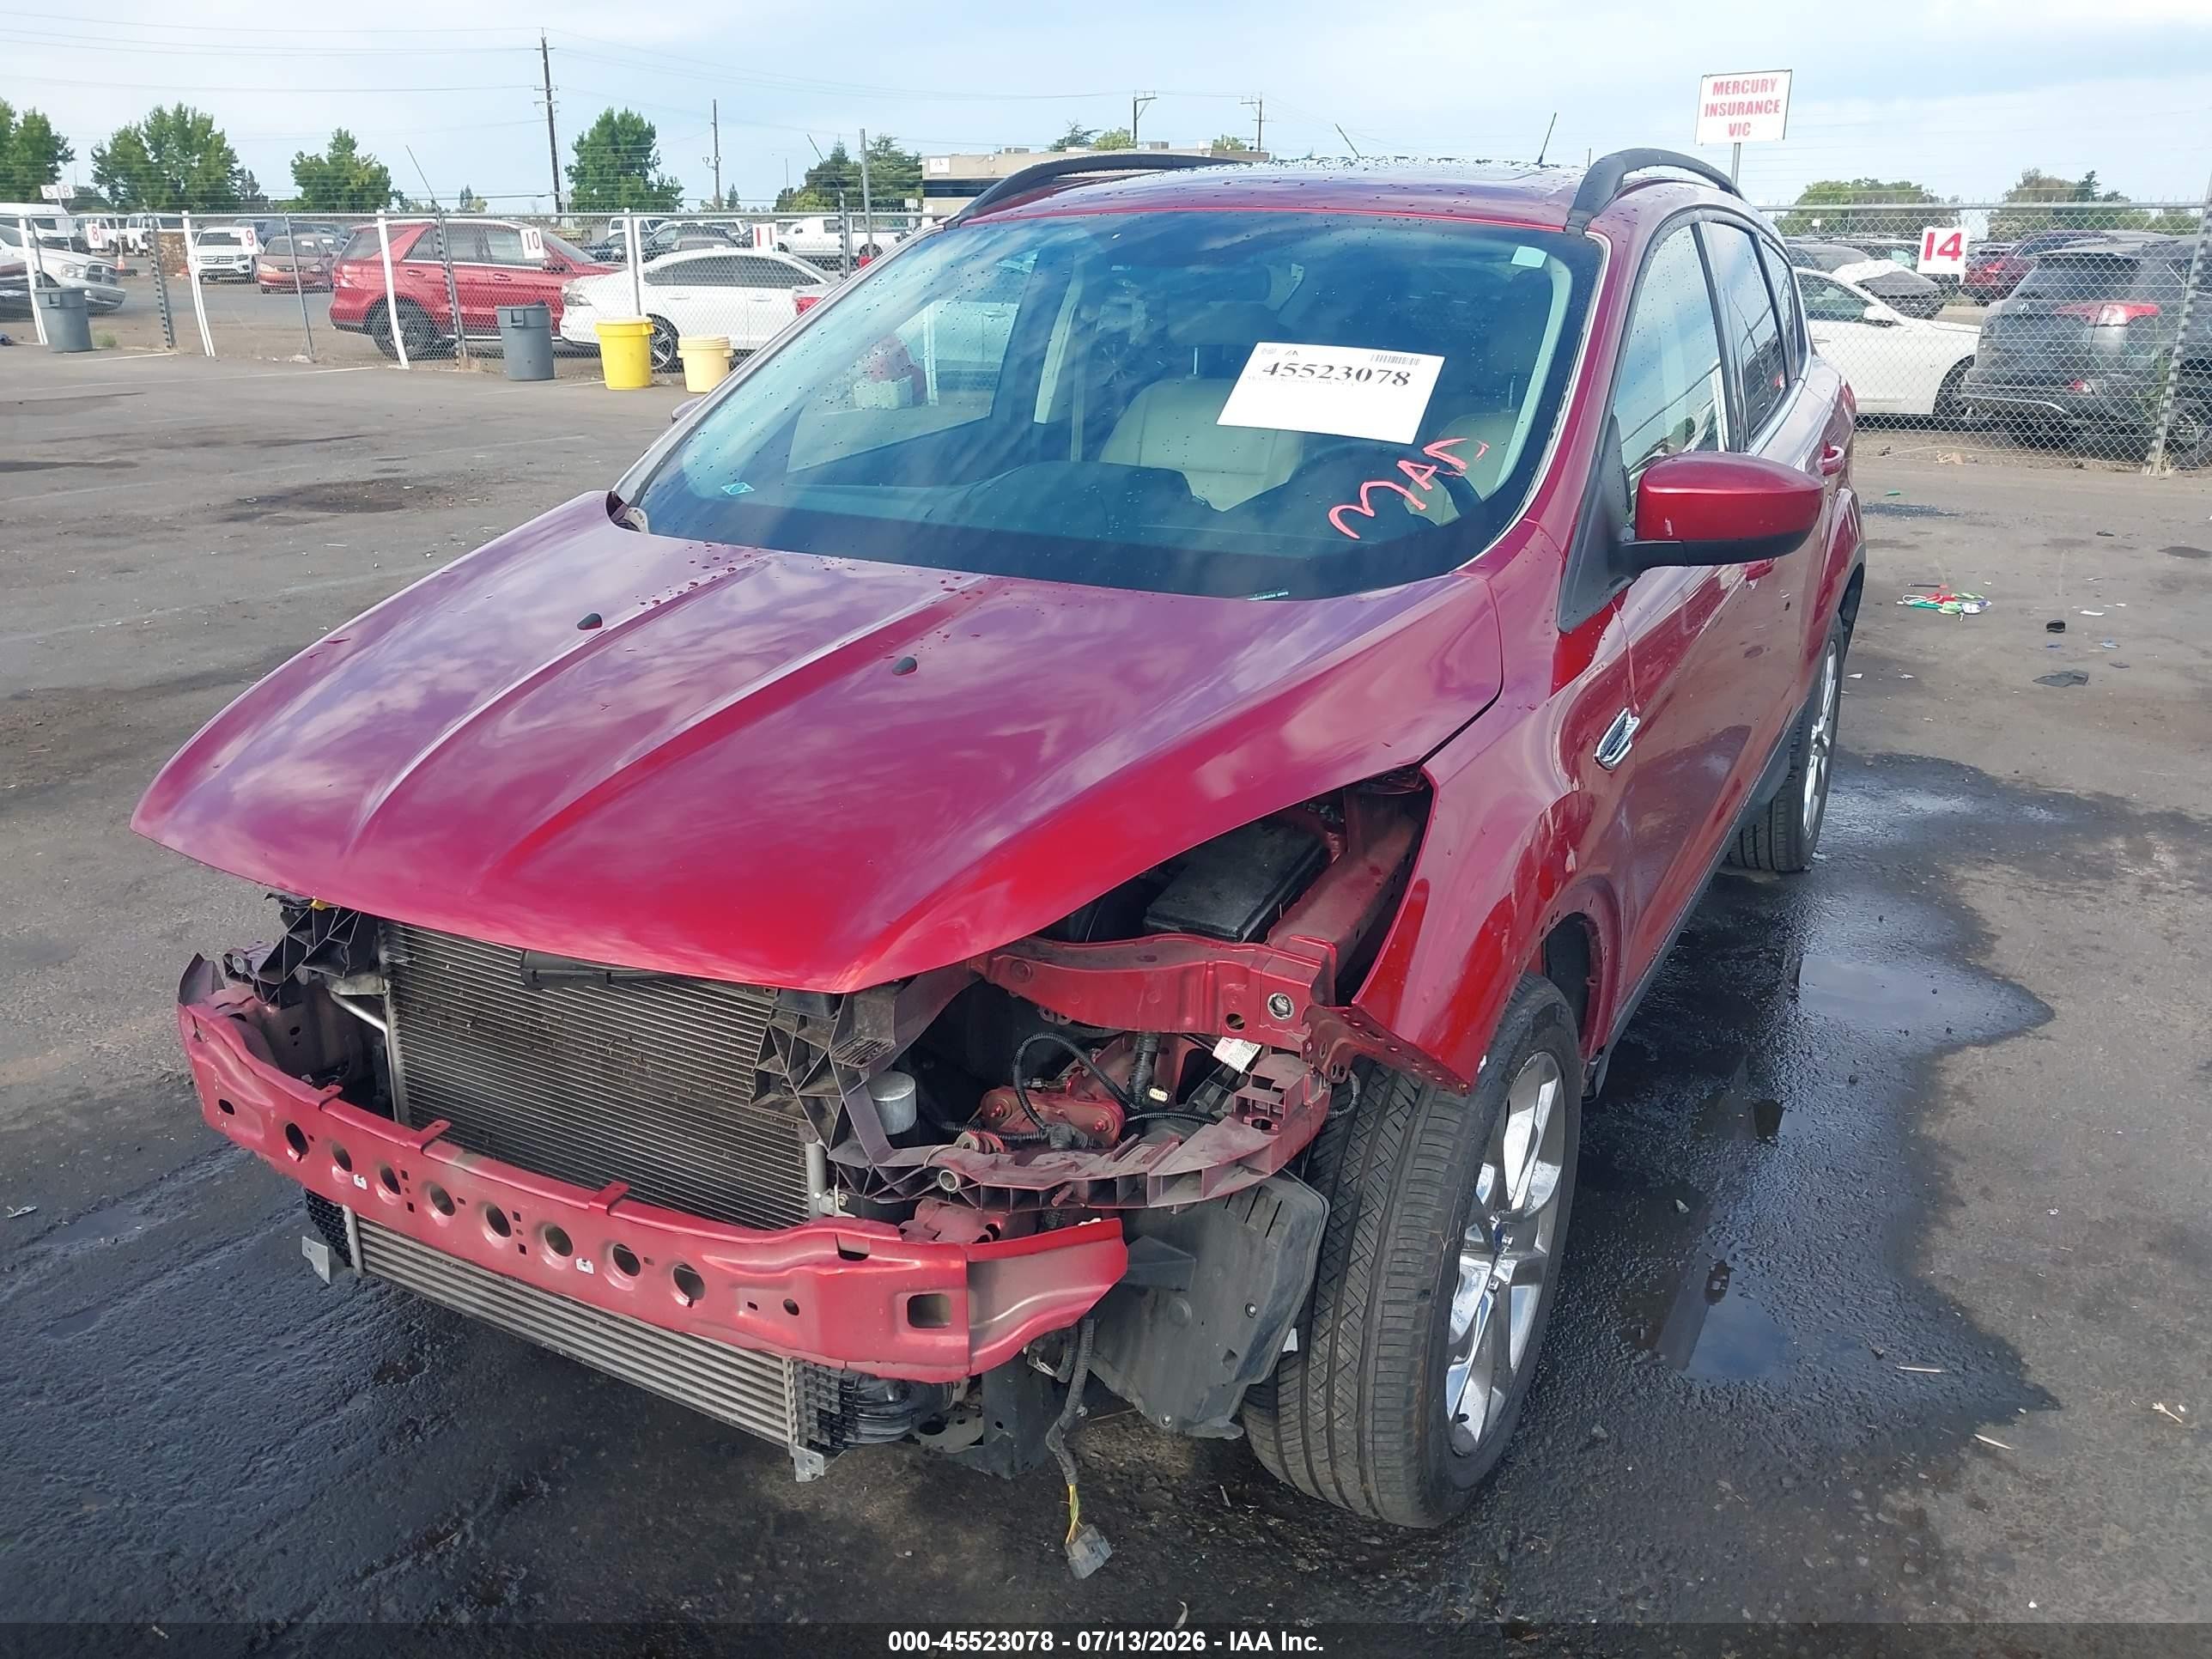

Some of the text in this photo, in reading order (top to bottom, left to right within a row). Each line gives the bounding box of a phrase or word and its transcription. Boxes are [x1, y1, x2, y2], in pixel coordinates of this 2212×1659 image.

[1712, 77, 1778, 96] MERCURY
[1705, 99, 1781, 117] INSURANCE
[1729, 122, 1752, 137] VIC
[91, 226, 100, 241] 8
[246, 229, 254, 246] 9
[526, 231, 540, 250] 10
[756, 226, 773, 247] 11
[1923, 232, 1963, 261] 14
[1262, 362, 1411, 386] 45523078
